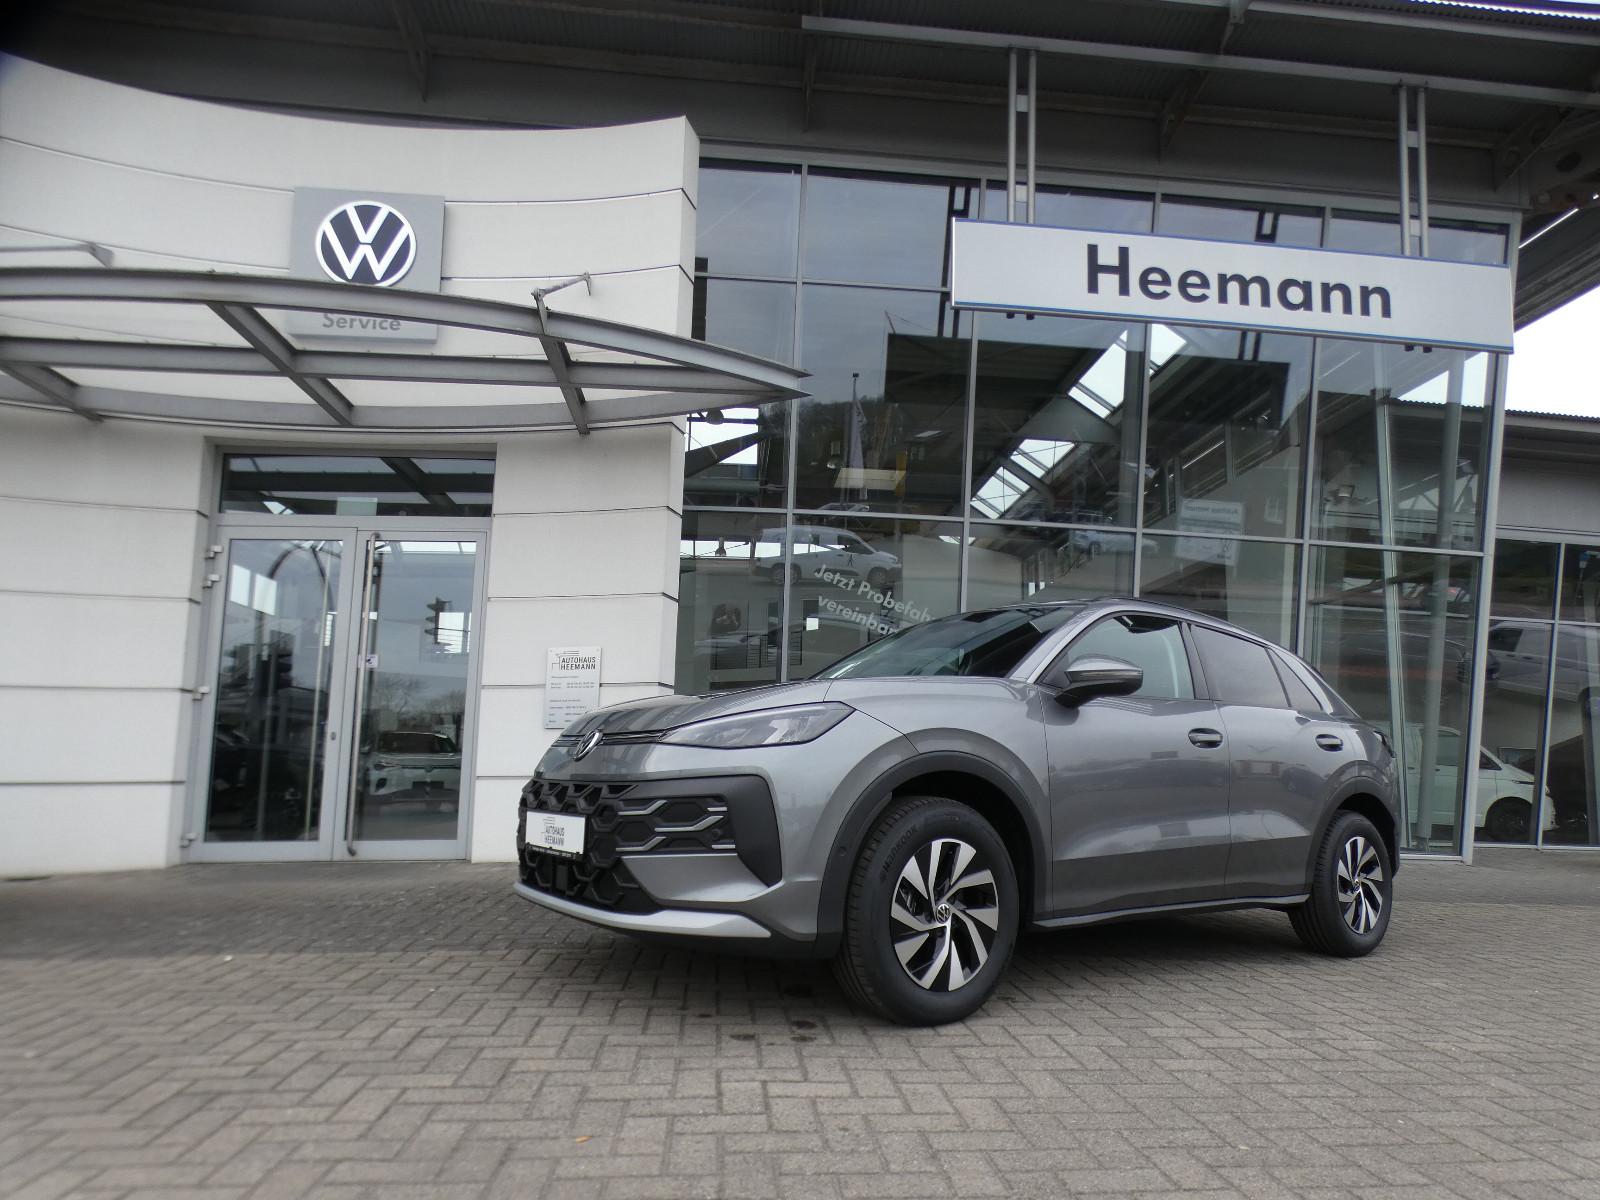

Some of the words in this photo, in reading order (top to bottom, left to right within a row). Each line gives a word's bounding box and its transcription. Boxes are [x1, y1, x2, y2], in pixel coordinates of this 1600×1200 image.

[1086, 243, 1392, 318] Heemann
[322, 312, 401, 331] Service
[814, 563, 855, 591] Jetzt
[857, 580, 937, 623] Probefah
[560, 663, 596, 671] HEEMANN
[561, 656, 596, 664] AUTOHAUS
